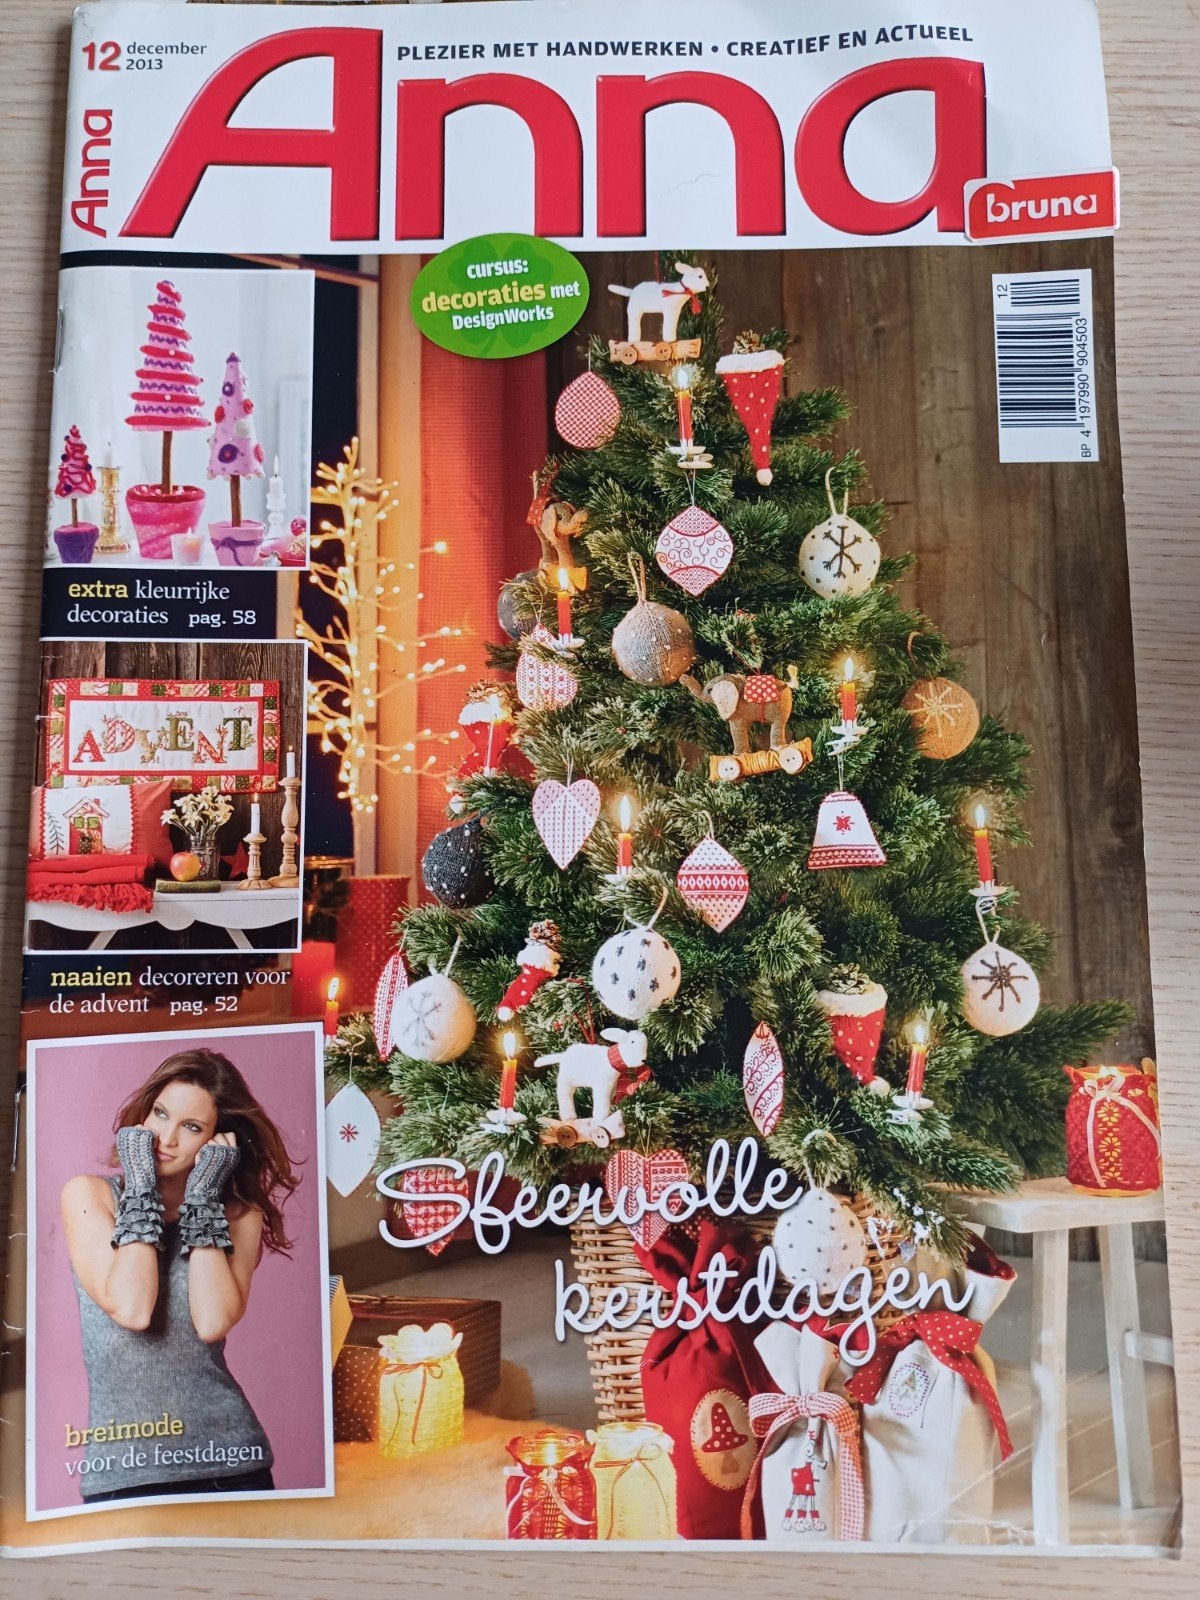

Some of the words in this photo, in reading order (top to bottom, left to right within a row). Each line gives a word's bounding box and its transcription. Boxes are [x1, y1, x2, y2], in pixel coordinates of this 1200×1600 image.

[82, 41, 121, 71] 12
[126, 41, 207, 55] december
[397, 44, 485, 61] PLEZIER
[493, 42, 539, 58] MET
[546, 41, 703, 57] HANDWERKEN
[726, 35, 831, 57] CREATIEF
[838, 30, 867, 50] EN
[874, 24, 973, 45] ACTUEEL
[126, 58, 163, 70] 2013
[118, 26, 988, 241] Anna
[70, 109, 113, 238] Anna
[986, 193, 1097, 224] bruna
[466, 258, 529, 279] cursus:
[421, 280, 547, 313] decoraties
[550, 280, 581, 299] met
[997, 284, 1008, 298] 12
[452, 304, 555, 330] DesignWorks
[1075, 317, 1088, 366] 904503
[1077, 373, 1090, 420] 197990
[1080, 443, 1092, 458] BP
[67, 580, 129, 598] extra
[134, 579, 230, 604] kleurrijke
[67, 604, 169, 624] decoraties
[188, 613, 226, 628] pag.
[232, 610, 256, 625] 58
[71, 711, 256, 764] ADVENT
[50, 966, 133, 987] naaien
[138, 965, 239, 986] decoreren
[244, 970, 290, 985] voor
[49, 993, 74, 1014] de
[80, 993, 150, 1013] advent
[169, 1000, 208, 1016] pag.
[214, 996, 238, 1012] 52
[376, 1136, 803, 1255] Sfeervolle
[553, 1246, 979, 1367] kerstdagen
[64, 1412, 184, 1447] breimode
[65, 1456, 116, 1476] voor
[121, 1446, 147, 1468] de
[153, 1441, 264, 1467] feestdagen
